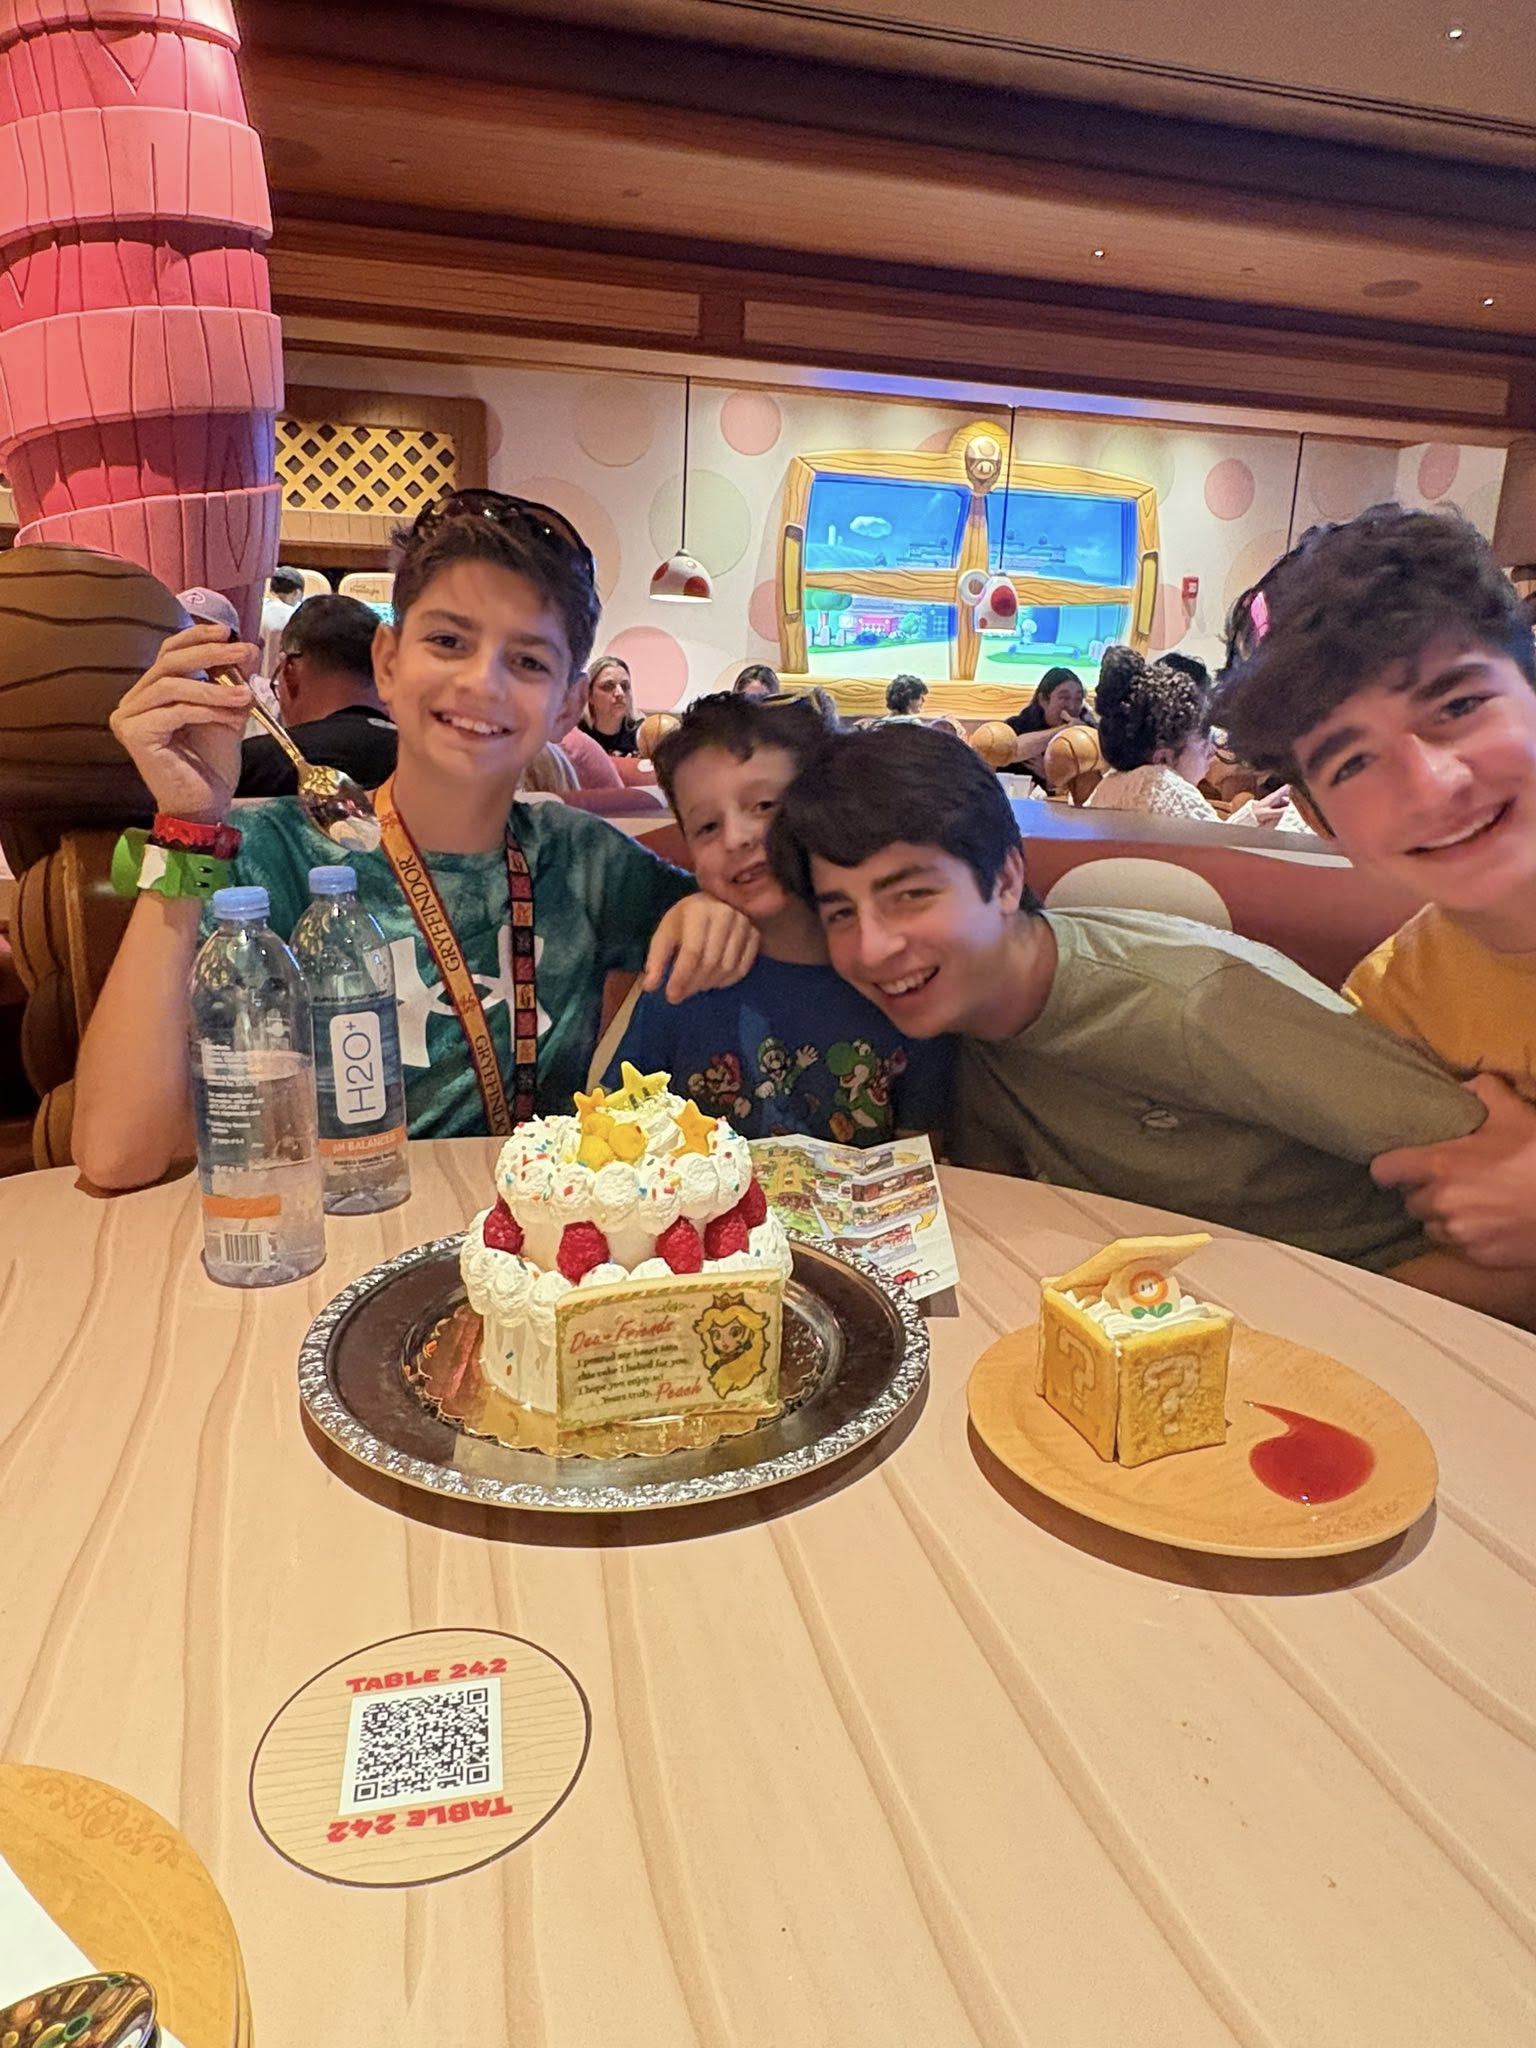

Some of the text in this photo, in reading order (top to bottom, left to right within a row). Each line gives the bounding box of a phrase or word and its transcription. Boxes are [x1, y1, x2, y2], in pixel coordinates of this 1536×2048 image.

[399, 855, 461, 972] GRYFFINDOR
[343, 1021, 376, 1113] H2O+
[475, 1035, 508, 1136] GRYFFINDO
[346, 1657, 508, 1694] TABLE 242
[326, 1796, 513, 1844] TABLE 242
